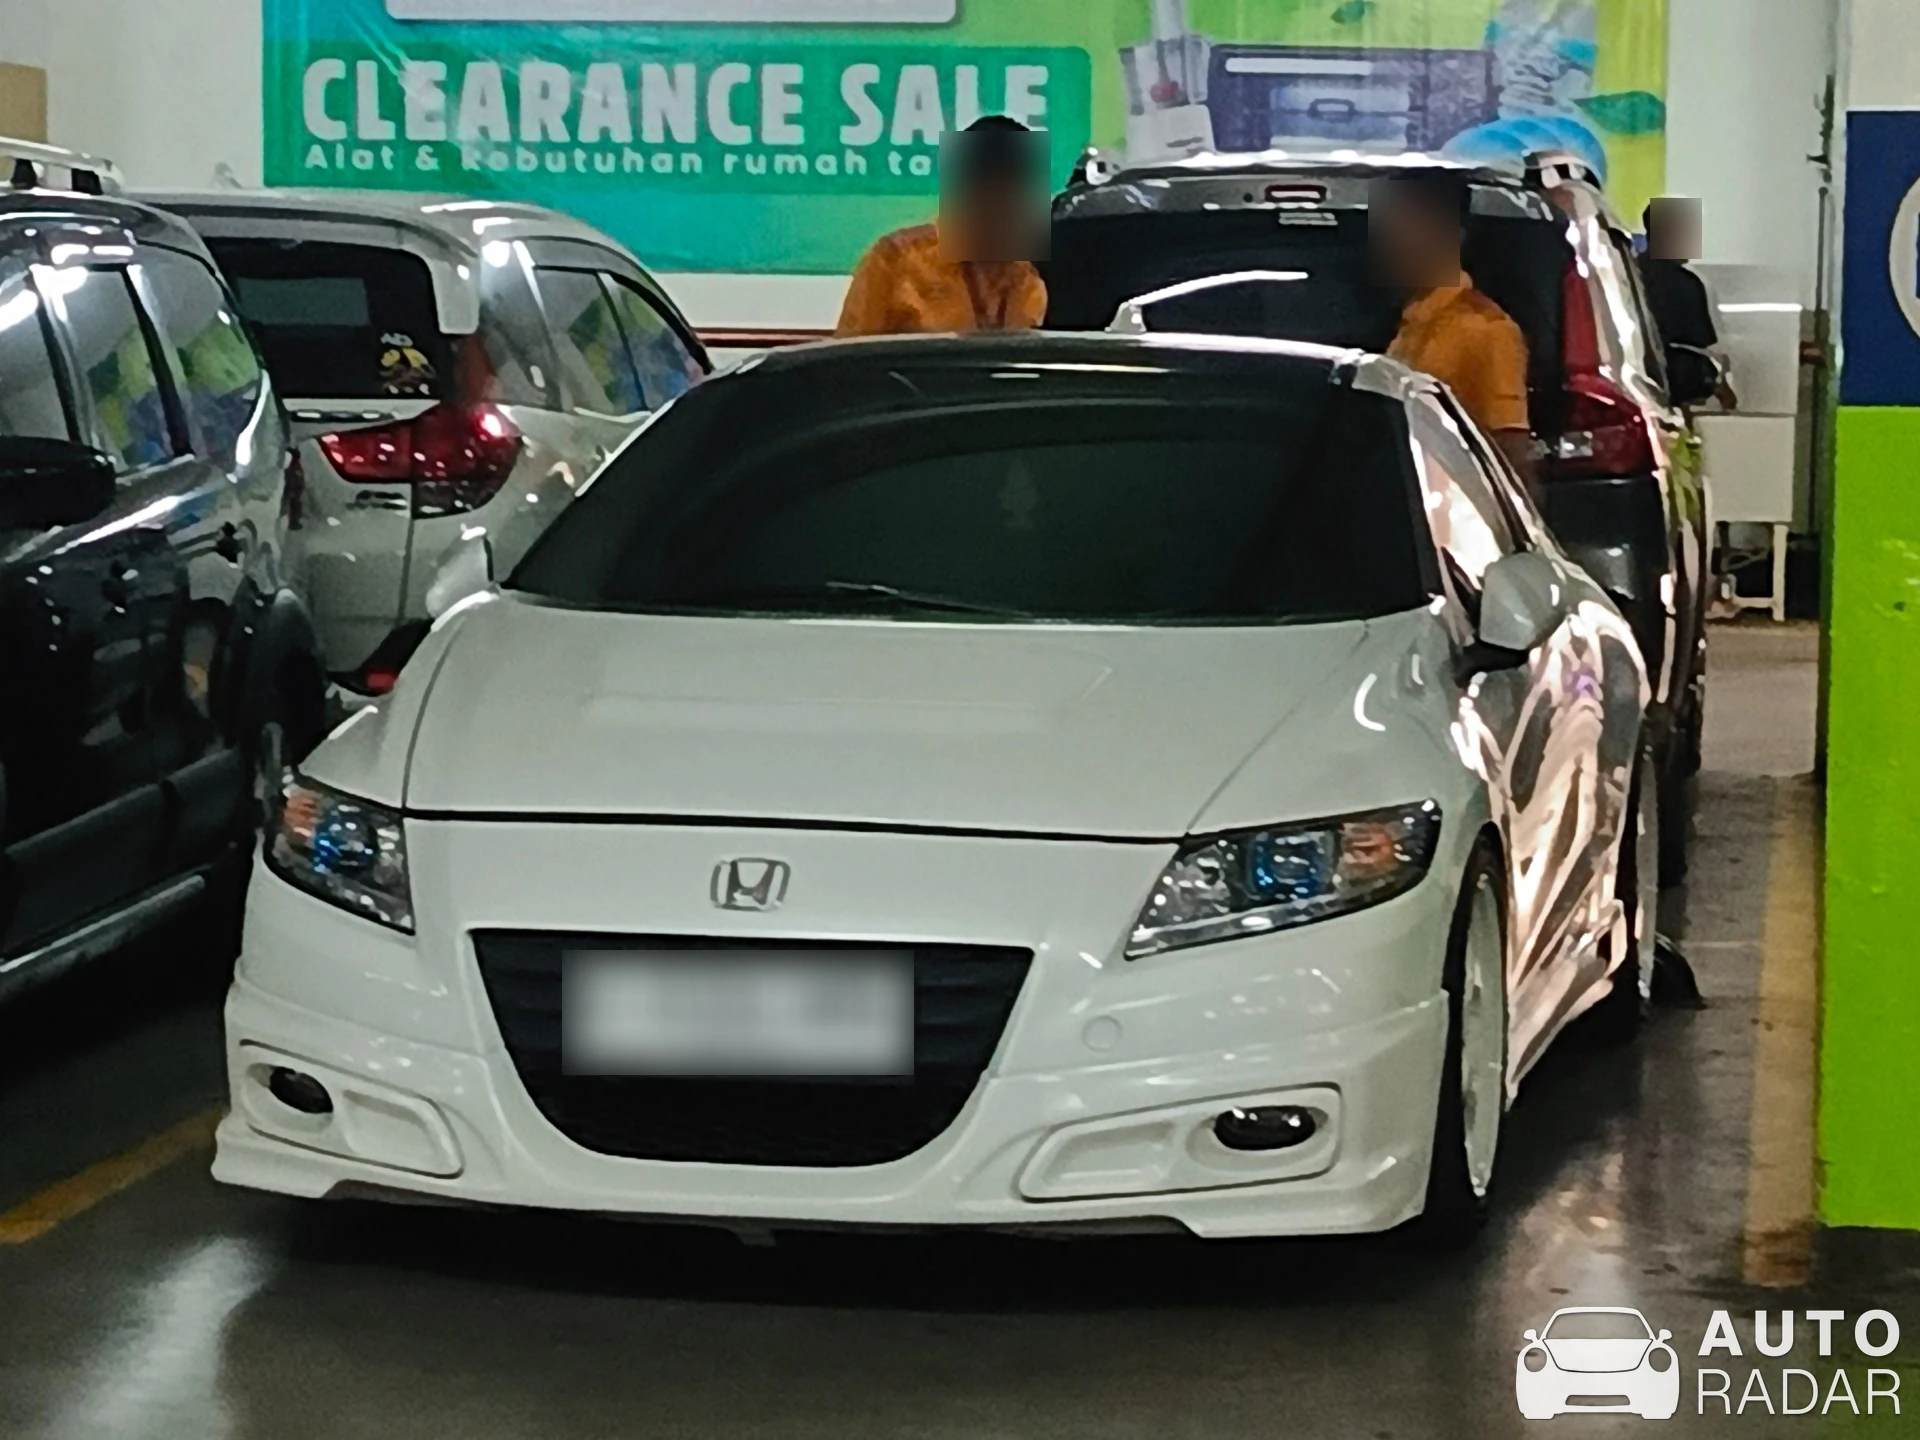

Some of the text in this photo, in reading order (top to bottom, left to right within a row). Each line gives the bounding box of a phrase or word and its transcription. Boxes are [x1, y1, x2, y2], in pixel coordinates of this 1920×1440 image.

[303, 58, 804, 145] CLEARANCE
[304, 142, 394, 170] Alat
[415, 144, 440, 171] &
[723, 148, 867, 175] rumah
